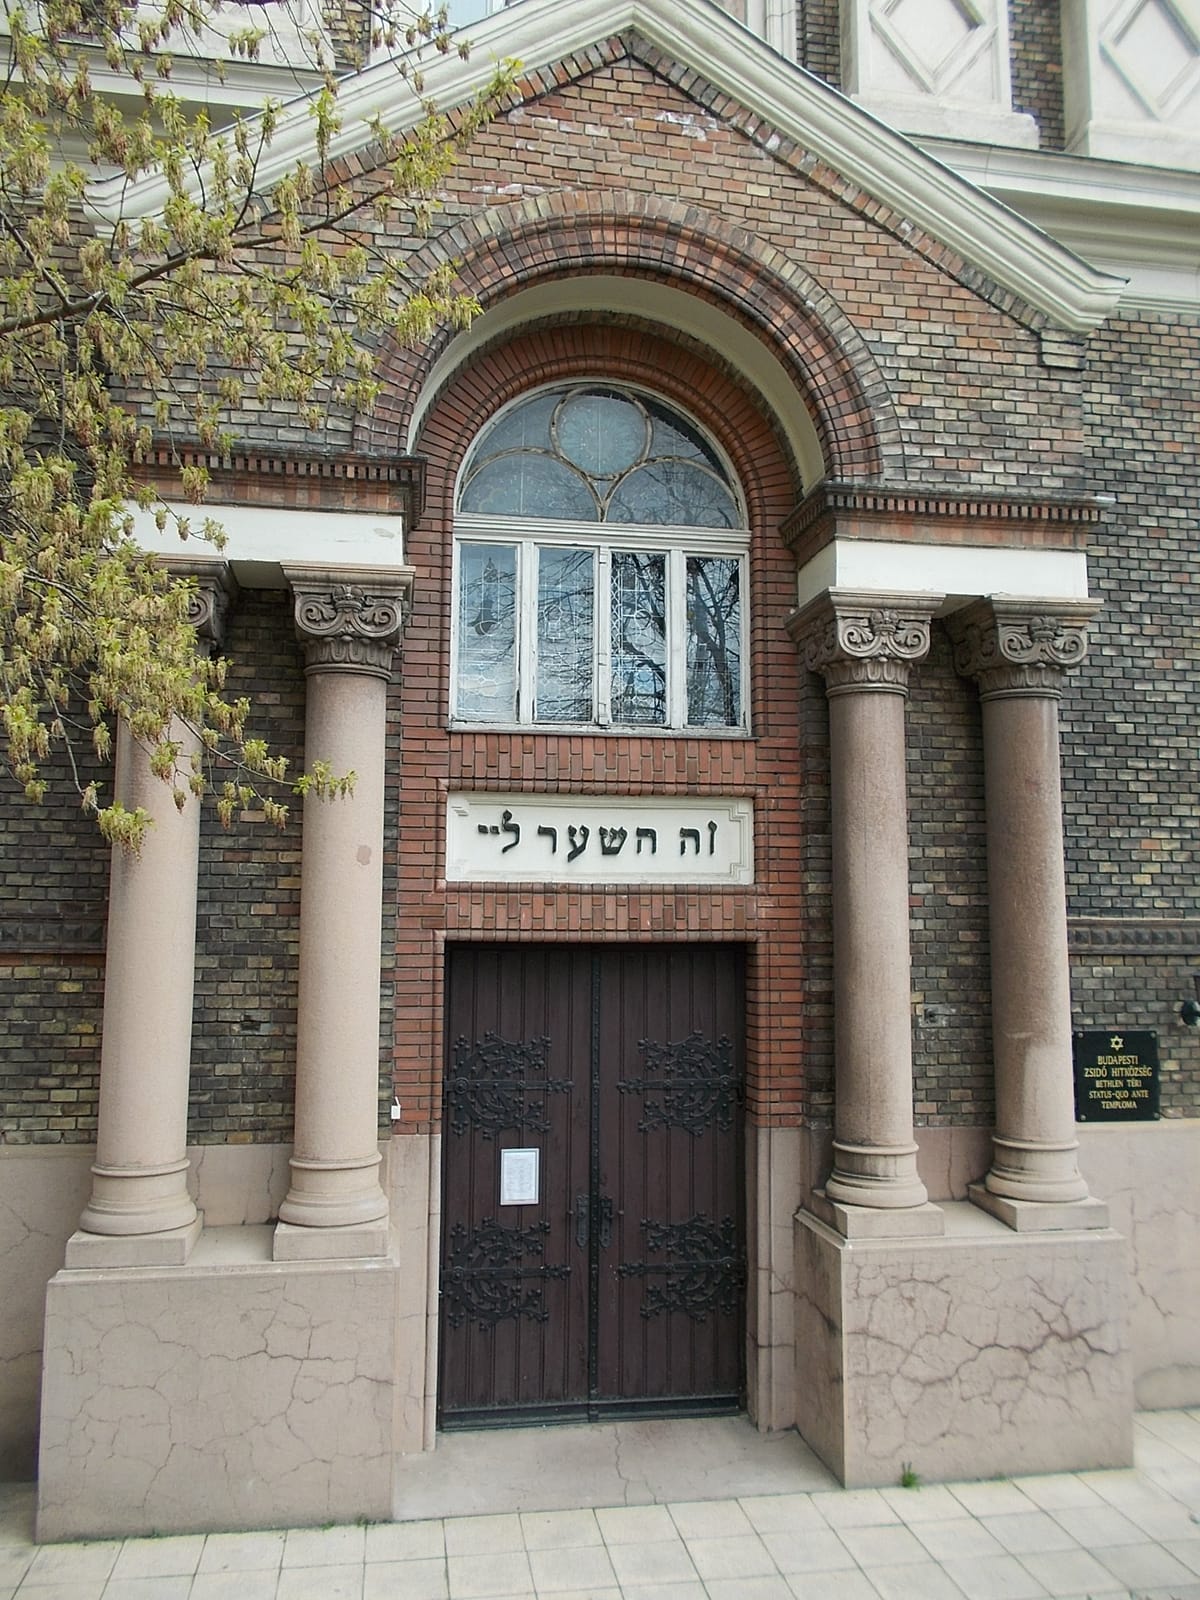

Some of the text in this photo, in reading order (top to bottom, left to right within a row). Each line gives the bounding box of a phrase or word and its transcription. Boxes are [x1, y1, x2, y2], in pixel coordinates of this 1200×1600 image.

[537, 824, 658, 863] השער
[680, 819, 719, 857] זה
[1097, 1055, 1139, 1065] BUDAPESTI
[1084, 1065, 1153, 1078] ZSIDÓ HITKÖZSÉG
[1095, 1078, 1142, 1088] BETHLEN TÉRI
[1088, 1089, 1149, 1100] STATUS-QUO ANTE
[1101, 1101, 1138, 1110] TEMPLOMA
